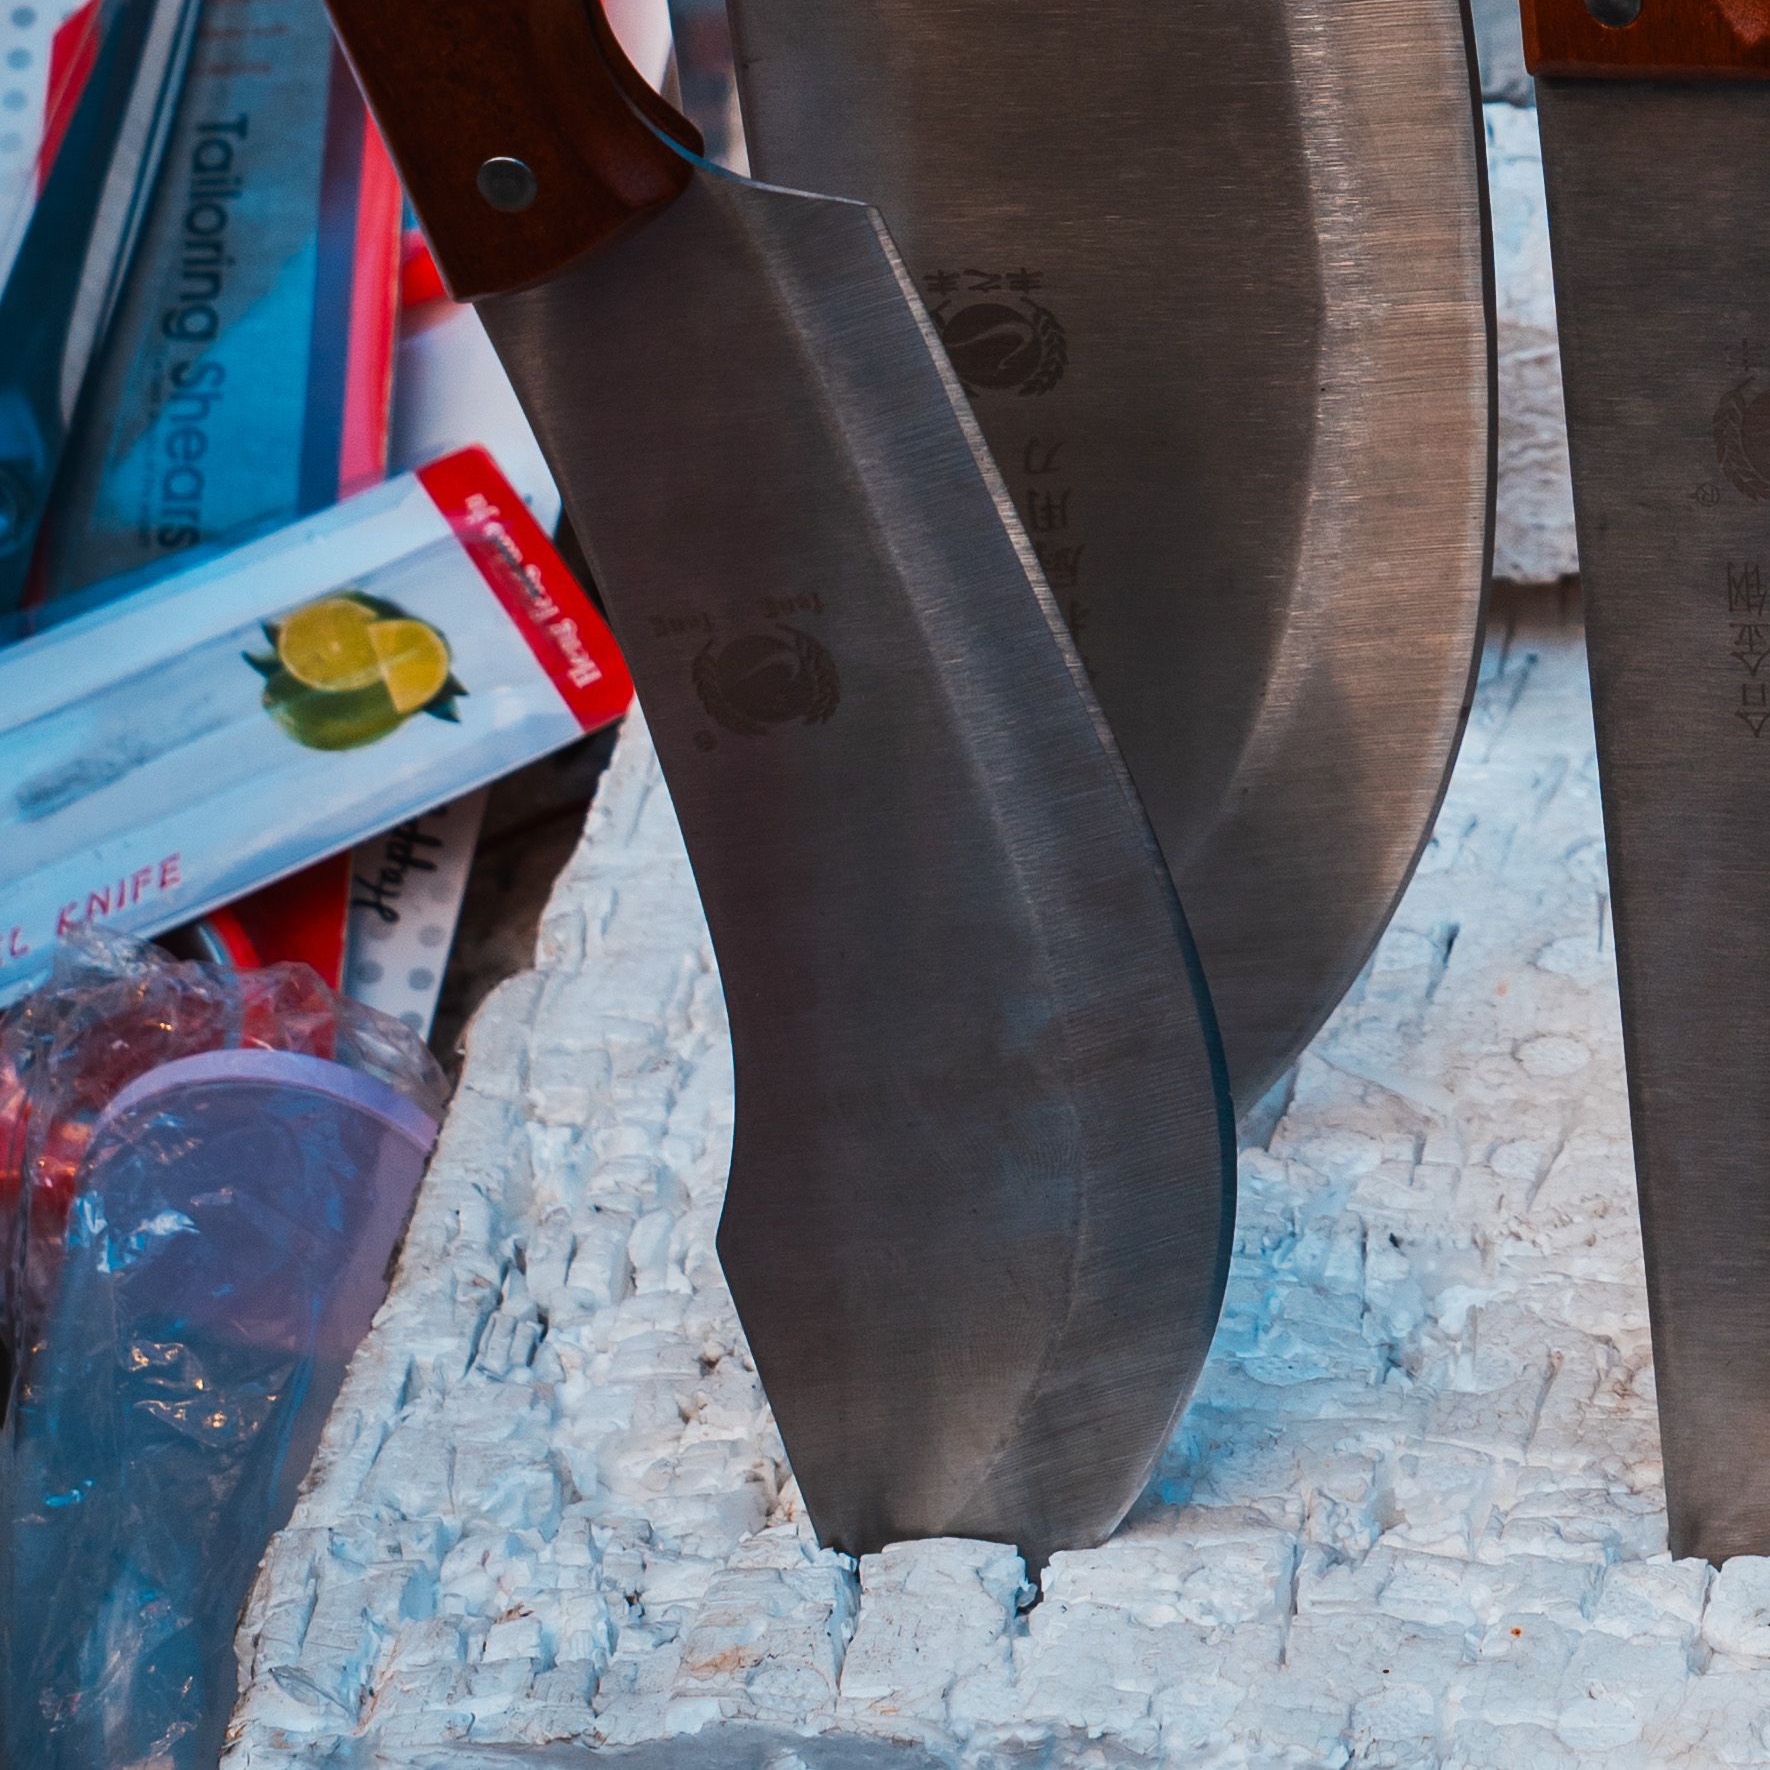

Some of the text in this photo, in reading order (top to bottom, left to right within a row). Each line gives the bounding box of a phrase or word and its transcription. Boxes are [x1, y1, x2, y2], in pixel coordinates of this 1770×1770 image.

[162, 111, 249, 345] Tailoring
[156, 361, 227, 548] Shears
[56, 852, 182, 938] KNIFE
